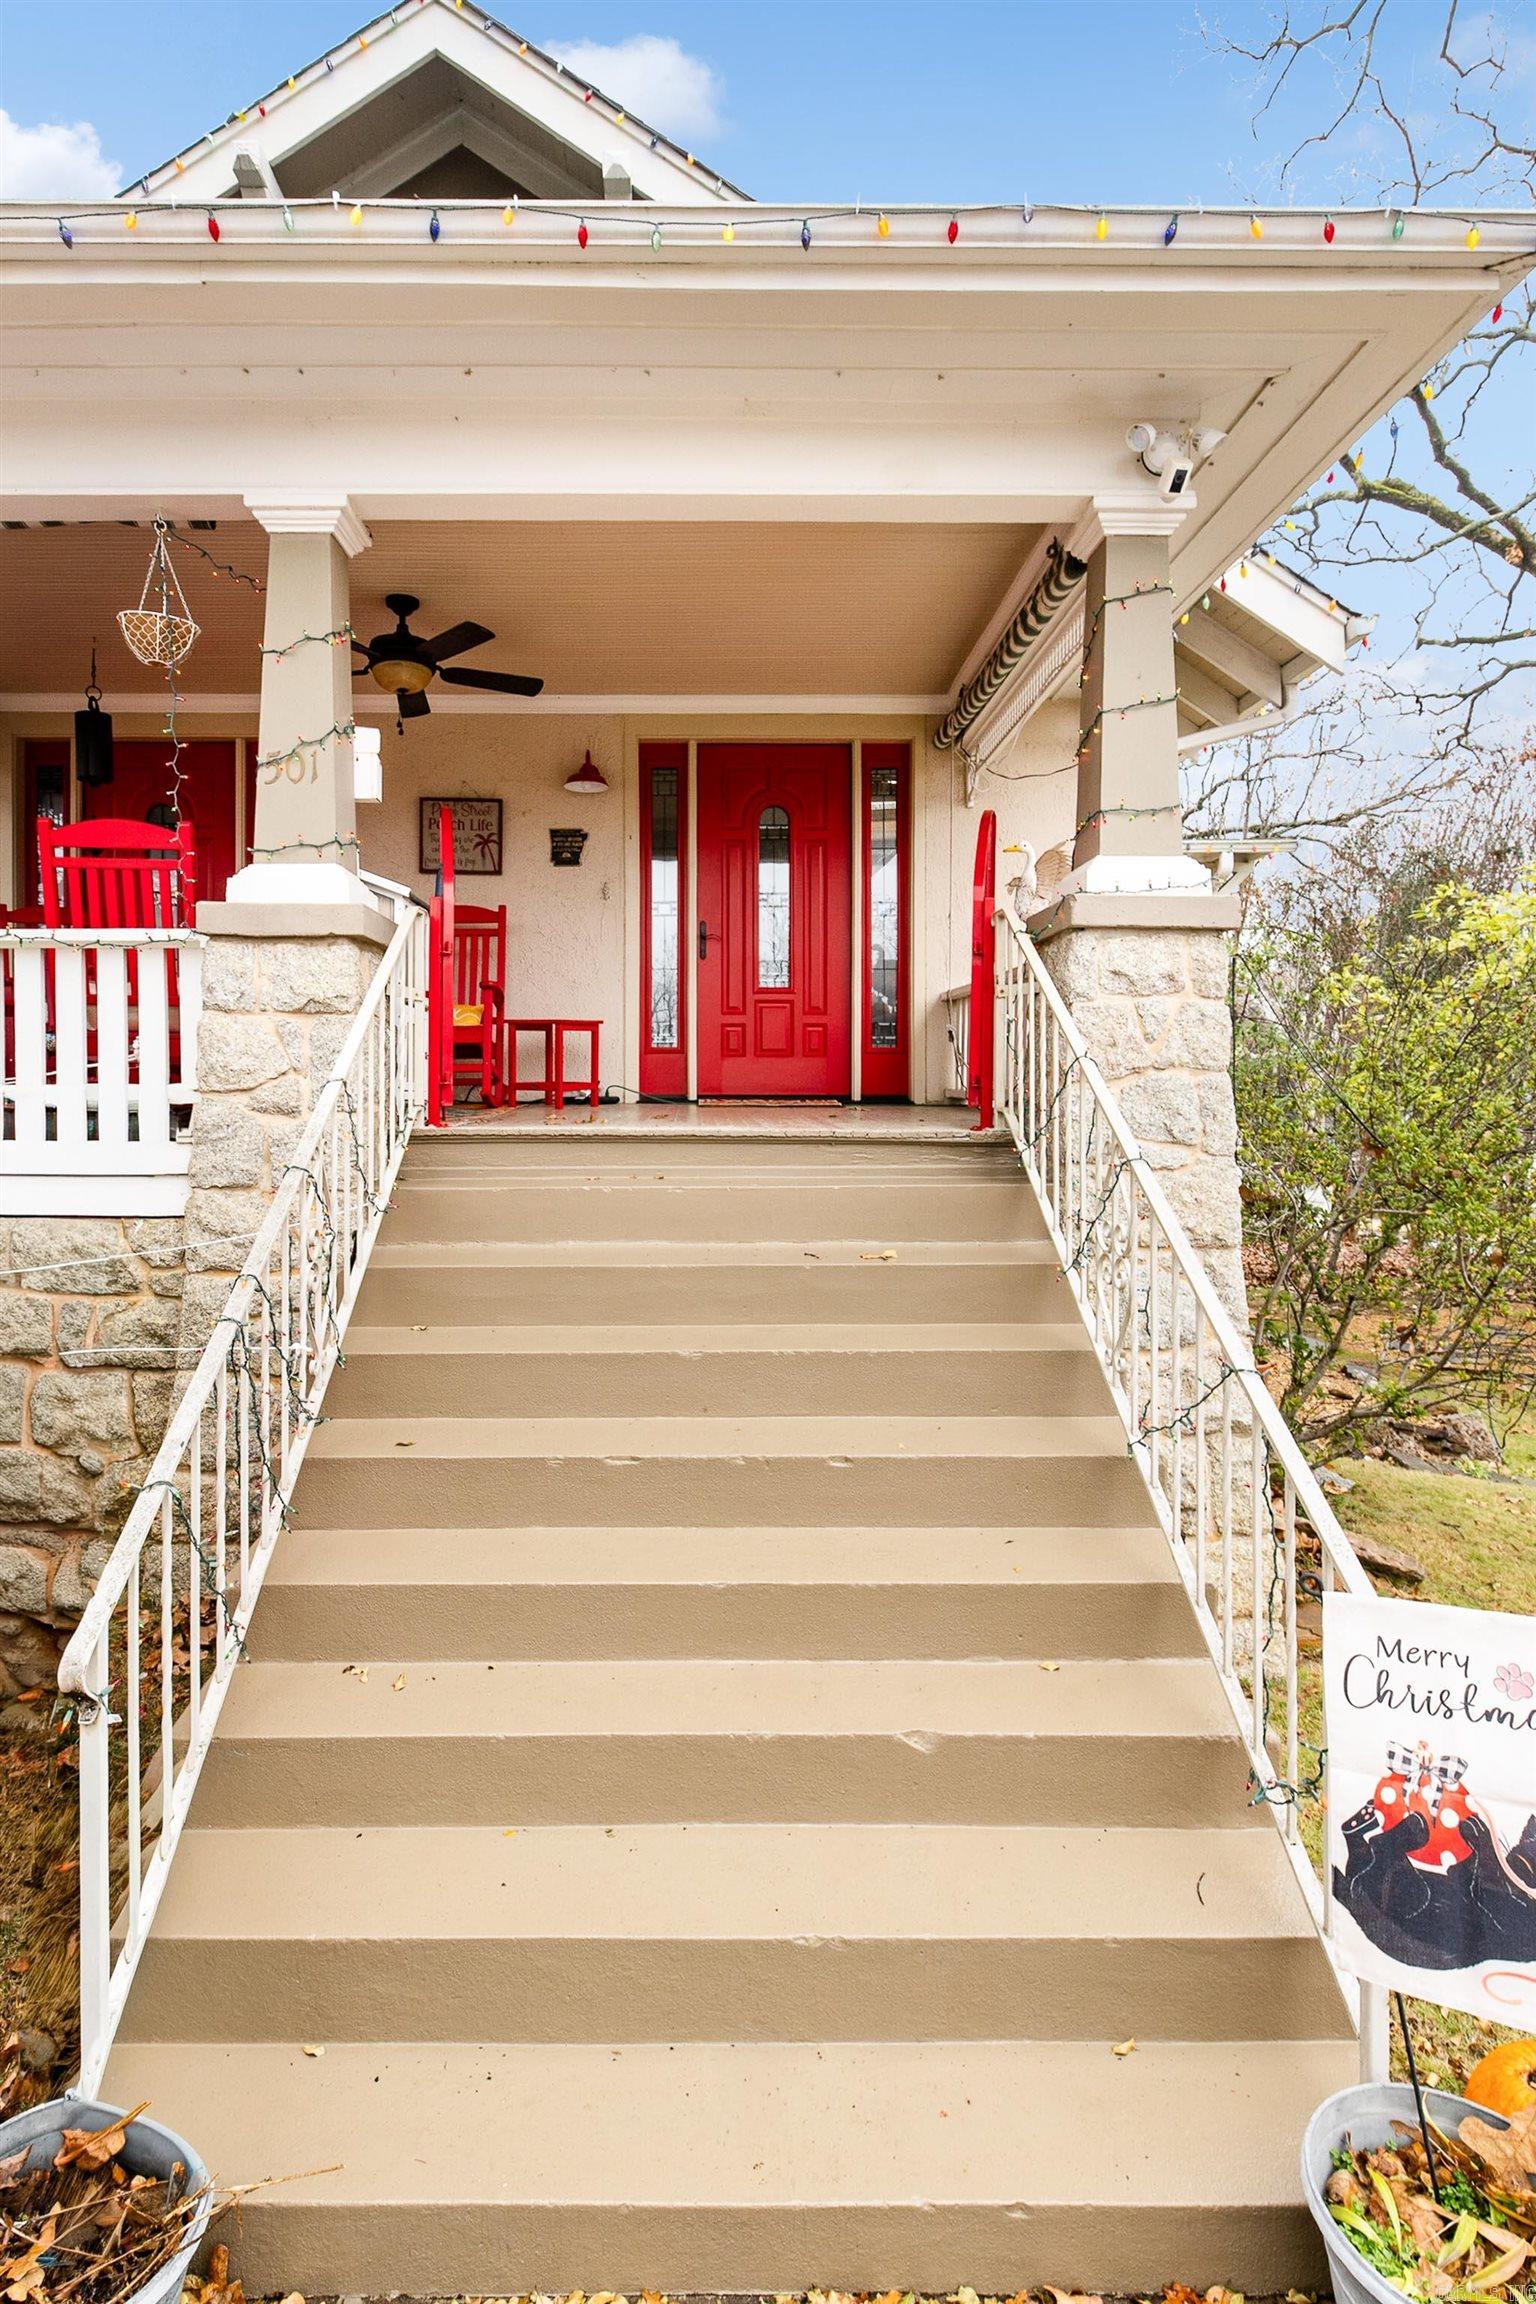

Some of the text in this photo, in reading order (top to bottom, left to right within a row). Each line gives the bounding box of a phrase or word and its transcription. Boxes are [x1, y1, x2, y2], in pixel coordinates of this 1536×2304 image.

[264, 749, 318, 785] 501
[429, 817, 494, 832] Pch Life
[1376, 1635, 1470, 1679] Merry
